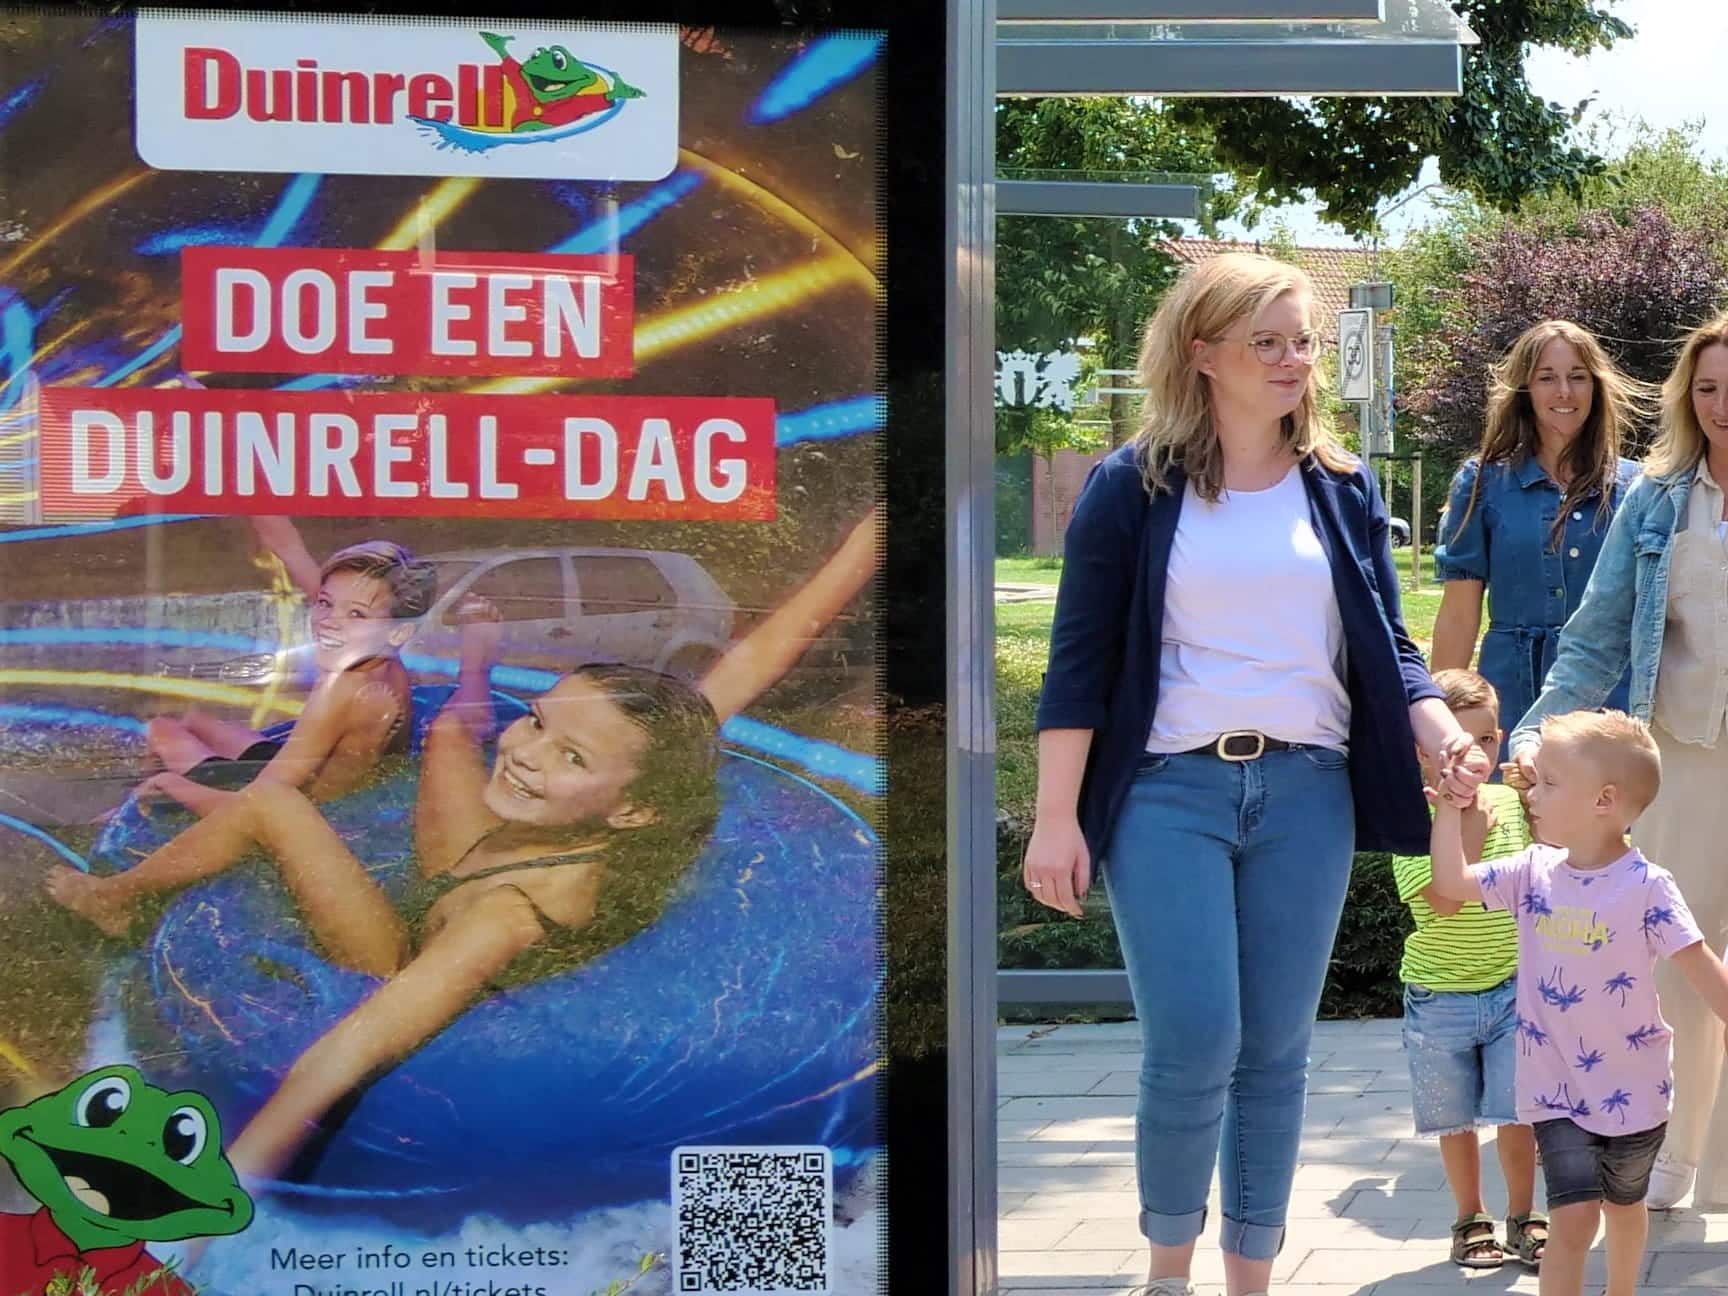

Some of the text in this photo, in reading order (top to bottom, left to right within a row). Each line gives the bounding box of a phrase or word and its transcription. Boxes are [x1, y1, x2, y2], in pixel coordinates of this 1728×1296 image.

[183, 46, 507, 128] Duinrell
[214, 266, 601, 359] DOE EEN
[70, 408, 748, 504] DUINRELL-DAG
[270, 1242, 569, 1270] Meer info en tickets:
